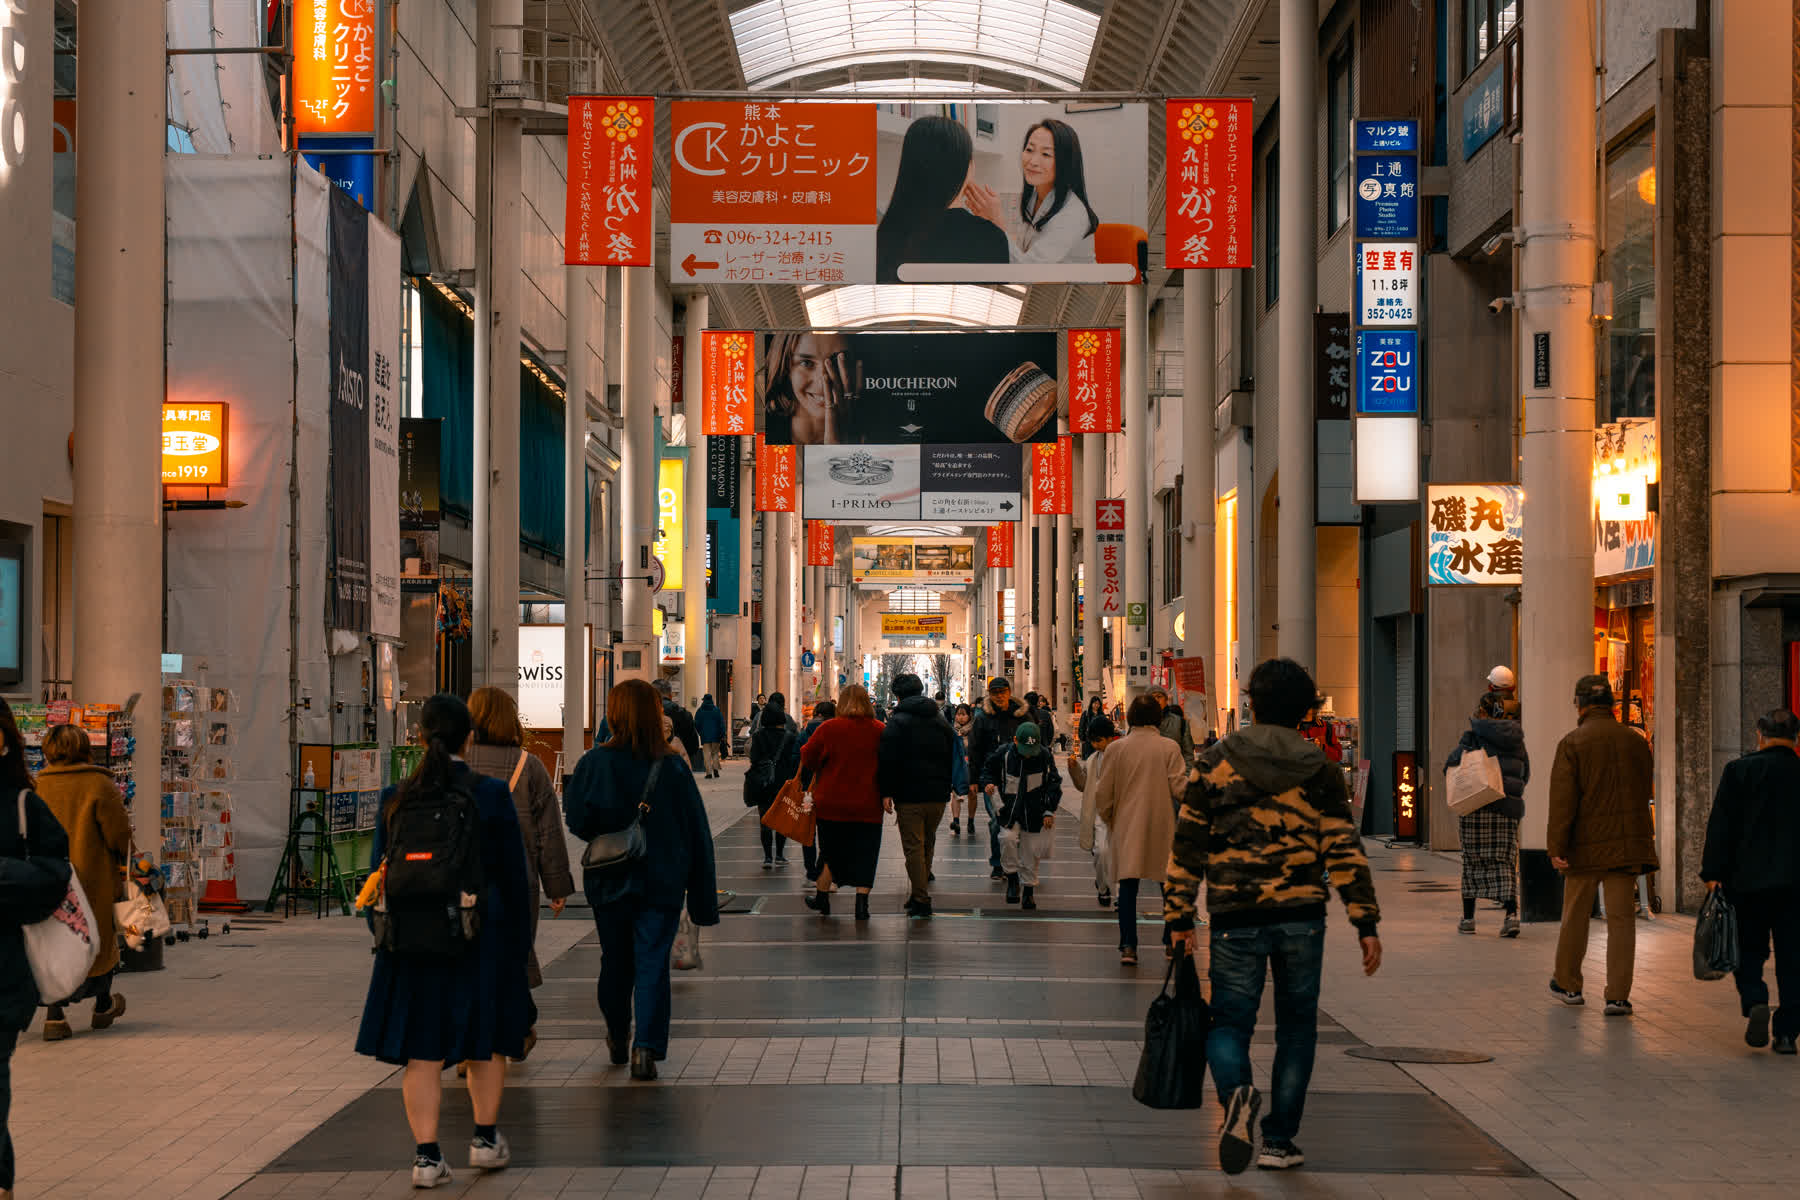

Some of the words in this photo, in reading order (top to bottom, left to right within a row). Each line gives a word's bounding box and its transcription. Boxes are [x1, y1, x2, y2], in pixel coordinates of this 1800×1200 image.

[332, 23, 351, 119] クリニック
[315, 99, 328, 110] 2F
[744, 104, 781, 121] 熊本
[740, 123, 816, 148] かよこ
[740, 152, 870, 177] クリニック
[1371, 161, 1402, 177] 上通
[712, 191, 831, 205] 美容皮膚科・皮膚科
[1362, 181, 1415, 199] 写真館
[1177, 146, 1216, 264] 九州がっ祭
[727, 229, 833, 245] 096-324-2415
[725, 251, 847, 265] レーザー治療・シミ
[1365, 249, 1414, 271] 空室有
[725, 268, 845, 282] ホクロ・ニキビ相談
[1372, 279, 1408, 291] 11.8坪
[1377, 298, 1403, 306] 連絡先
[1367, 308, 1413, 319] 352-0425
[1371, 351, 1411, 368] ZOU
[865, 377, 958, 390] BOUCHERON
[1371, 376, 1411, 393] ZOU
[1075, 358, 1099, 430] 九州がっ祭
[178, 465, 208, 478] 1919
[717, 454, 726, 498] DIAMOND
[832, 499, 892, 509] I-PRIMO
[1098, 503, 1122, 528] 本
[1431, 495, 1506, 533] 磯丸
[1448, 537, 1523, 576] 水産
[1102, 544, 1120, 612] まるぶん
